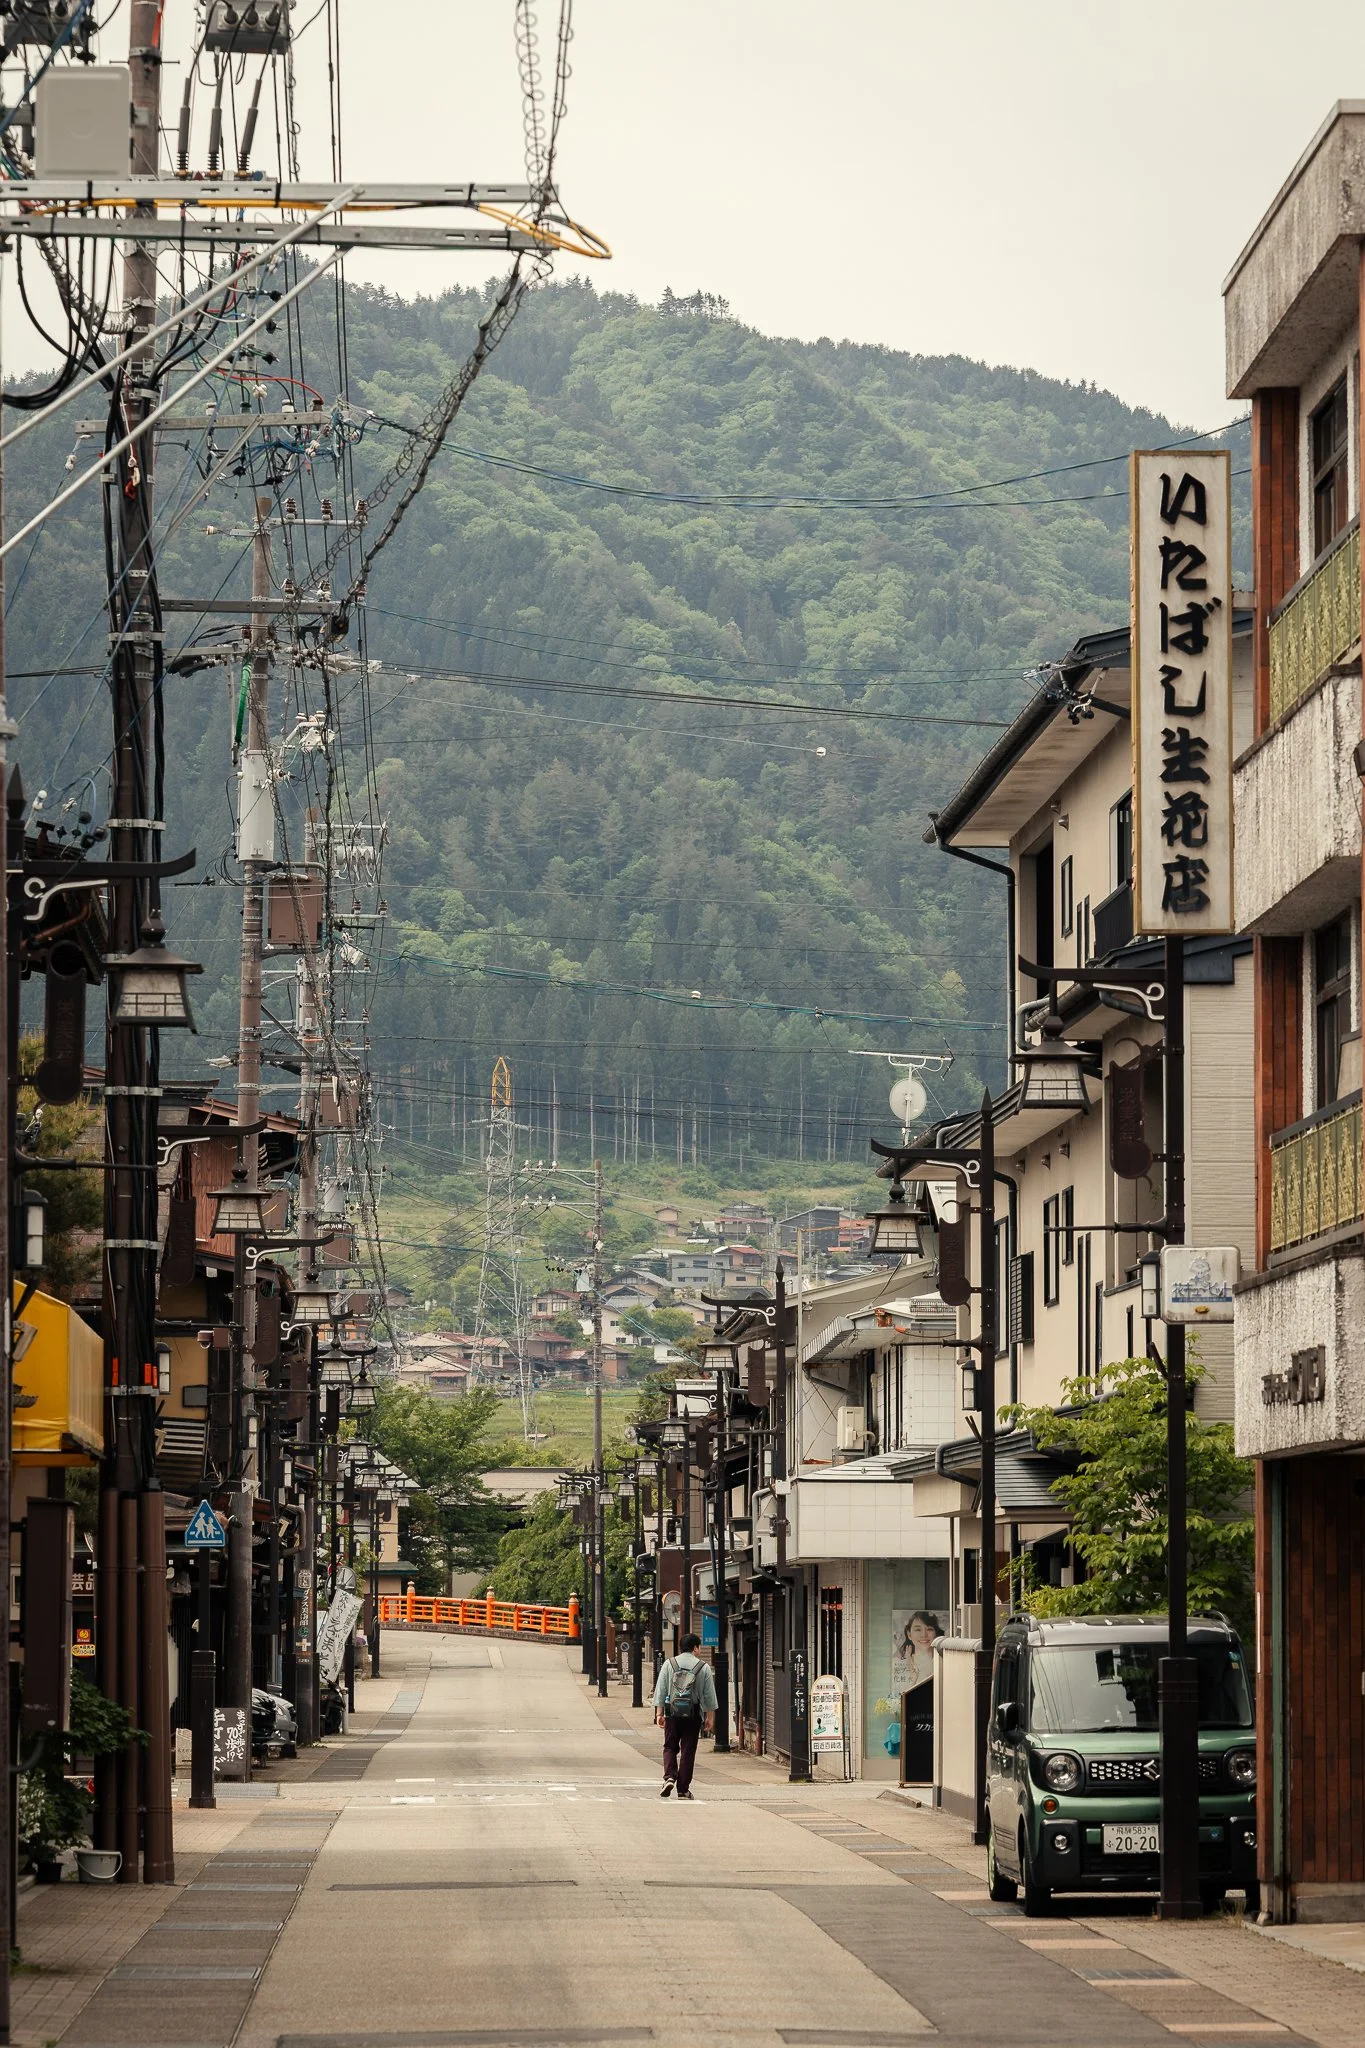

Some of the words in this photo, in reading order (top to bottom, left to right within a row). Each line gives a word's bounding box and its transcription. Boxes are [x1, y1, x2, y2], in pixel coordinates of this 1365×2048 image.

[1158, 471, 1222, 914] いたばし生花店
[1115, 1835, 1157, 1851] 20-20
